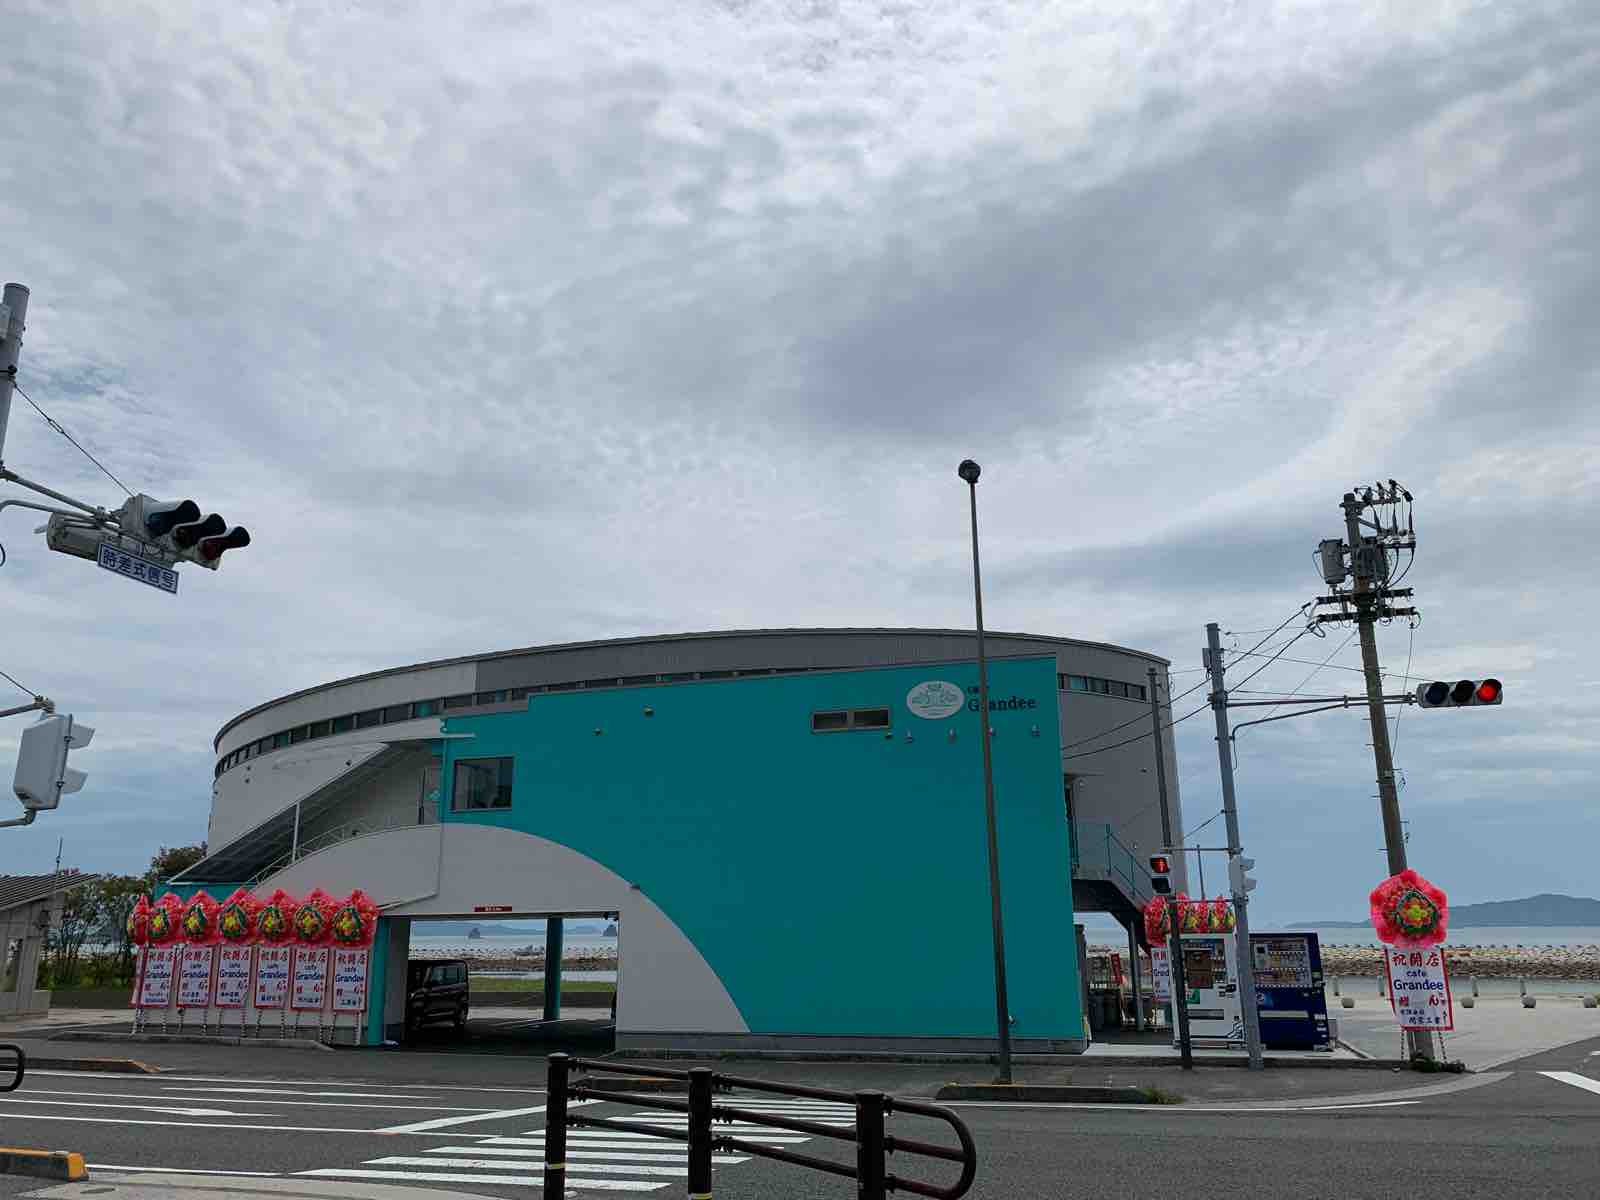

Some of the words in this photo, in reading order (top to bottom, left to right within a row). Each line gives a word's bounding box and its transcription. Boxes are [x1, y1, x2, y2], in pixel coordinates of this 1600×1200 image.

[967, 695, 1036, 712] Gandee
[1392, 951, 1440, 967] 祝開店
[1406, 969, 1427, 977] cafe
[1393, 979, 1444, 991] Grandee
